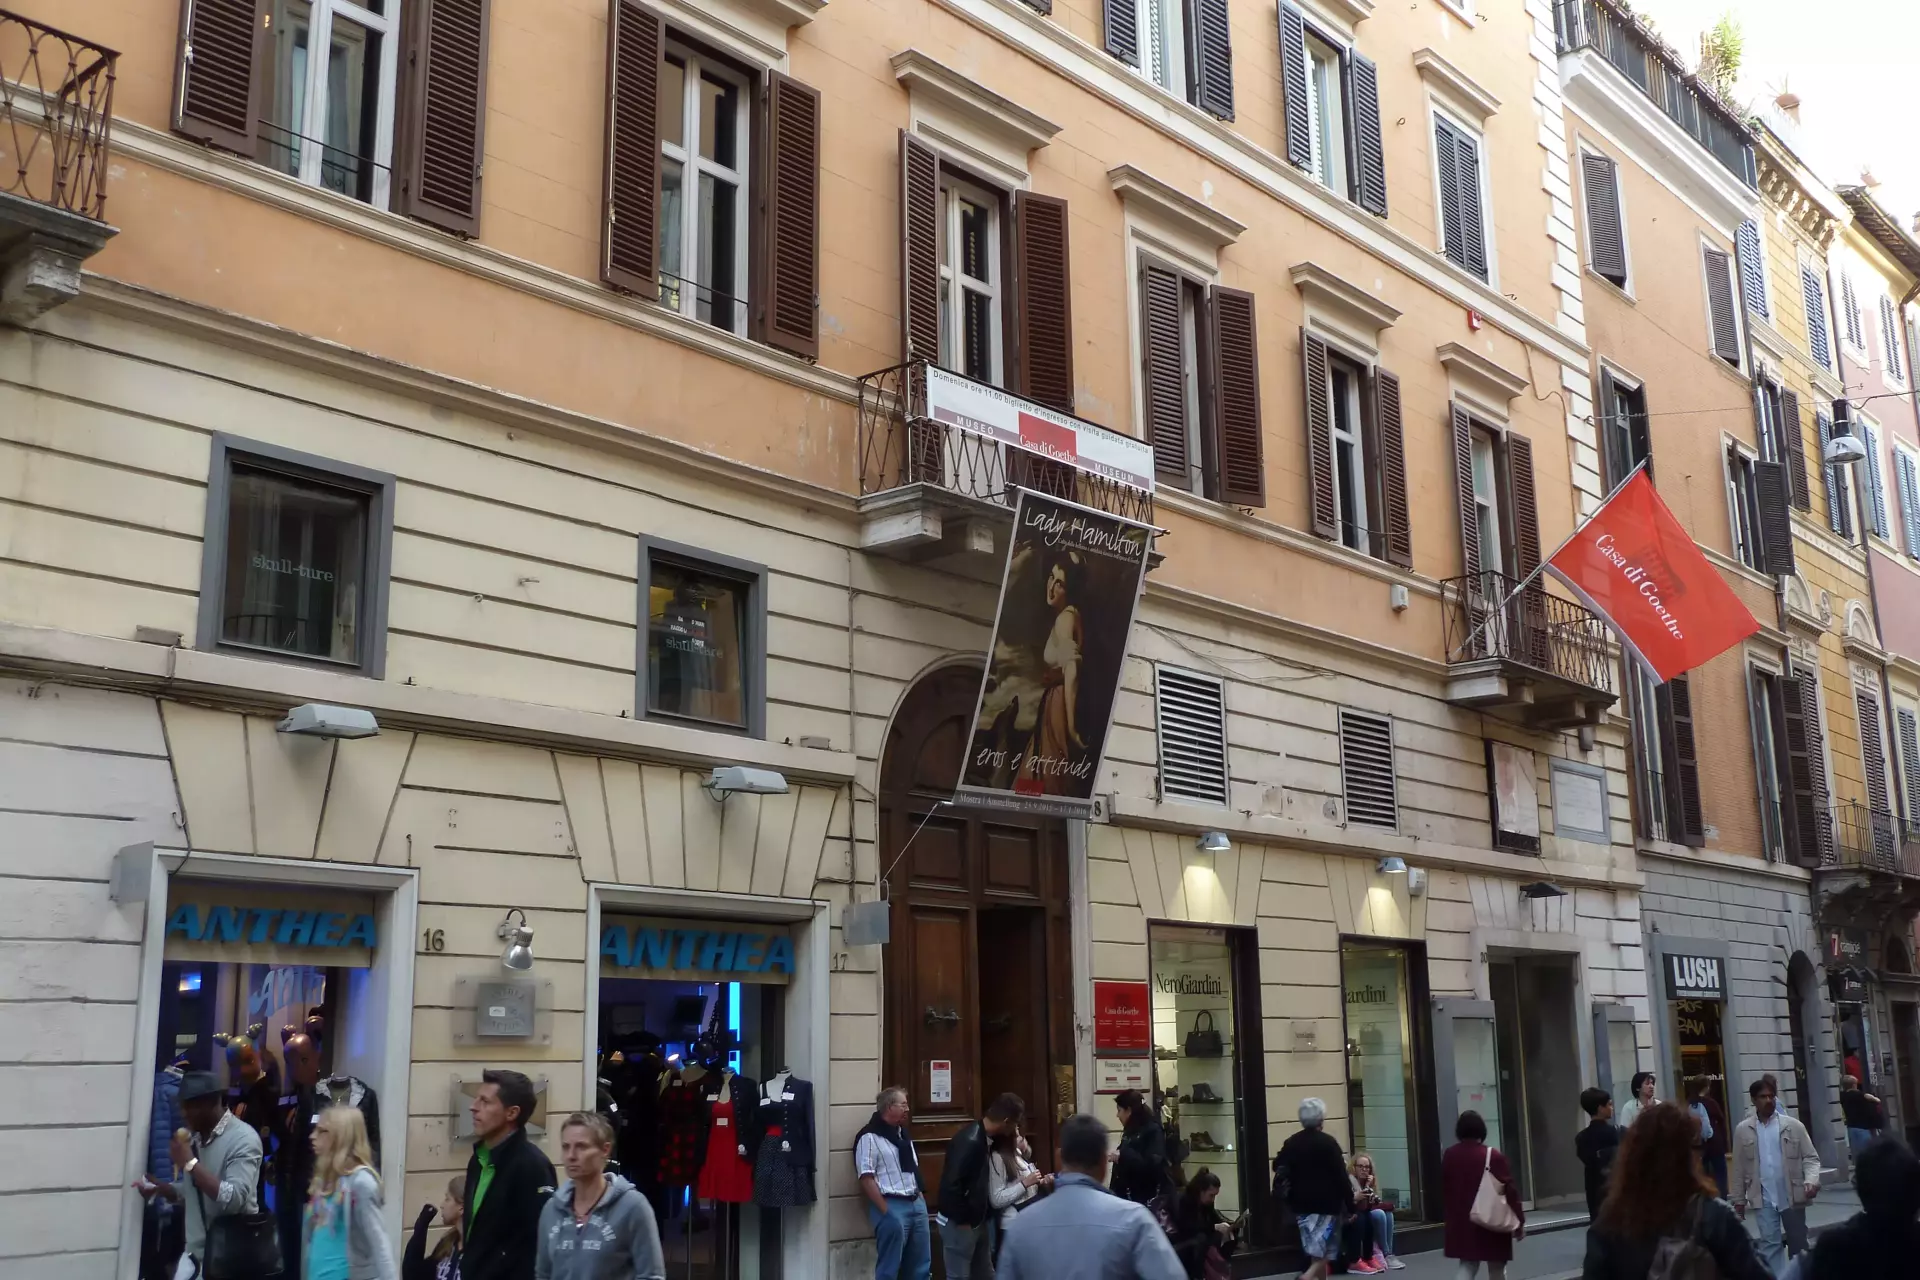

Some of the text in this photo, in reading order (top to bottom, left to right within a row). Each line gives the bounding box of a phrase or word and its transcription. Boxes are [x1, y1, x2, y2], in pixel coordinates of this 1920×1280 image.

[933, 370, 1149, 454] Domenica ore 11.00 biglietto d'ingresso con visita guidata gratuita
[956, 415, 994, 435] MUSEO
[1020, 434, 1077, 464] Casa di Goethe
[1094, 463, 1134, 483] MUSEUM
[1025, 507, 1066, 546] Lady
[1070, 517, 1142, 557] Hamilton
[1595, 534, 1684, 641] Casa di Goethe
[977, 748, 1092, 779] eros e attitude
[166, 903, 377, 948] ANTHEA
[423, 928, 445, 951] 16
[600, 925, 796, 974] ANTHEA
[833, 952, 848, 970] 17
[1156, 973, 1222, 995] NeroGiardini
[1673, 956, 1720, 988] LUSH
